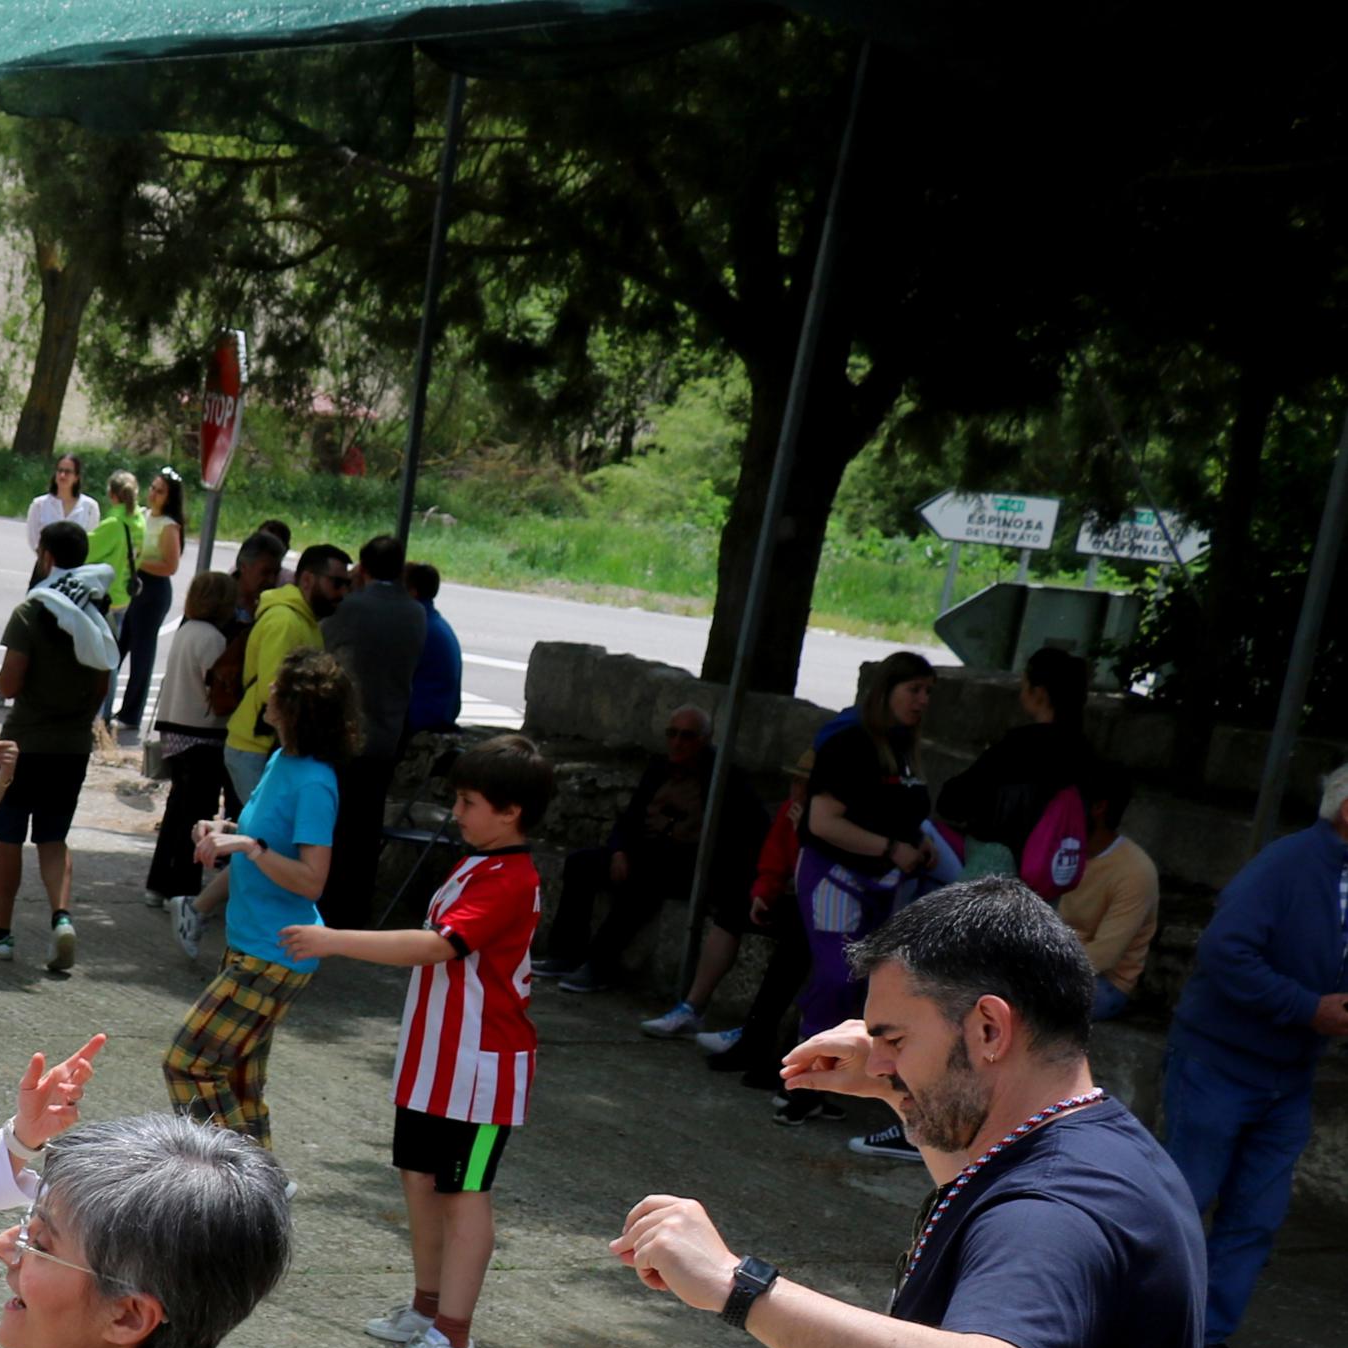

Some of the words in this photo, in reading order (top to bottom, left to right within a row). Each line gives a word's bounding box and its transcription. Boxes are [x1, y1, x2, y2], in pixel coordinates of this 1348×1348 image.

[204, 394, 234, 428] STOP
[967, 513, 1044, 531] ESPINOSA
[987, 529, 1041, 543] CERRATO
